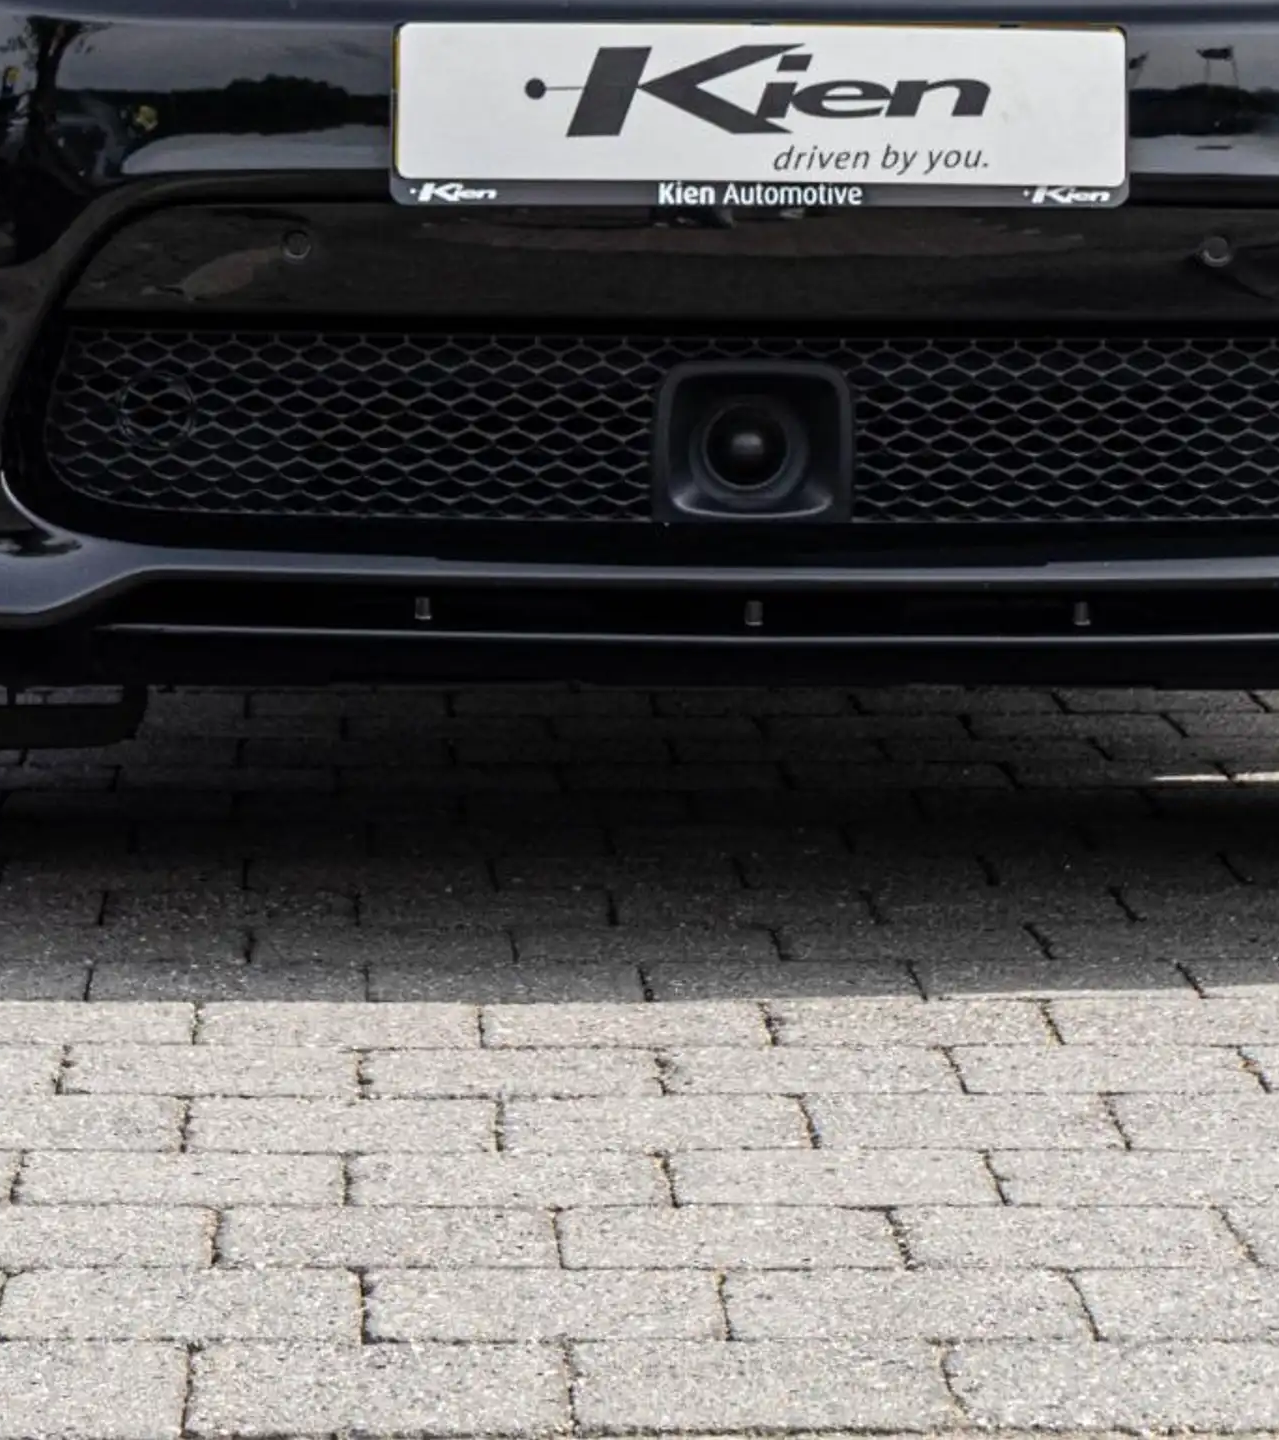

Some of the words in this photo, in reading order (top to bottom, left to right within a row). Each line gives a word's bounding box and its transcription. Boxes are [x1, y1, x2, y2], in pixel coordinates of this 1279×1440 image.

[566, 44, 991, 138] Kien
[773, 144, 871, 172] driven
[880, 143, 918, 176] by
[923, 149, 990, 176] you.
[418, 183, 498, 203] Kien
[658, 183, 716, 205] Kien
[722, 184, 863, 206] Automotive
[1031, 186, 1112, 205] Kien
